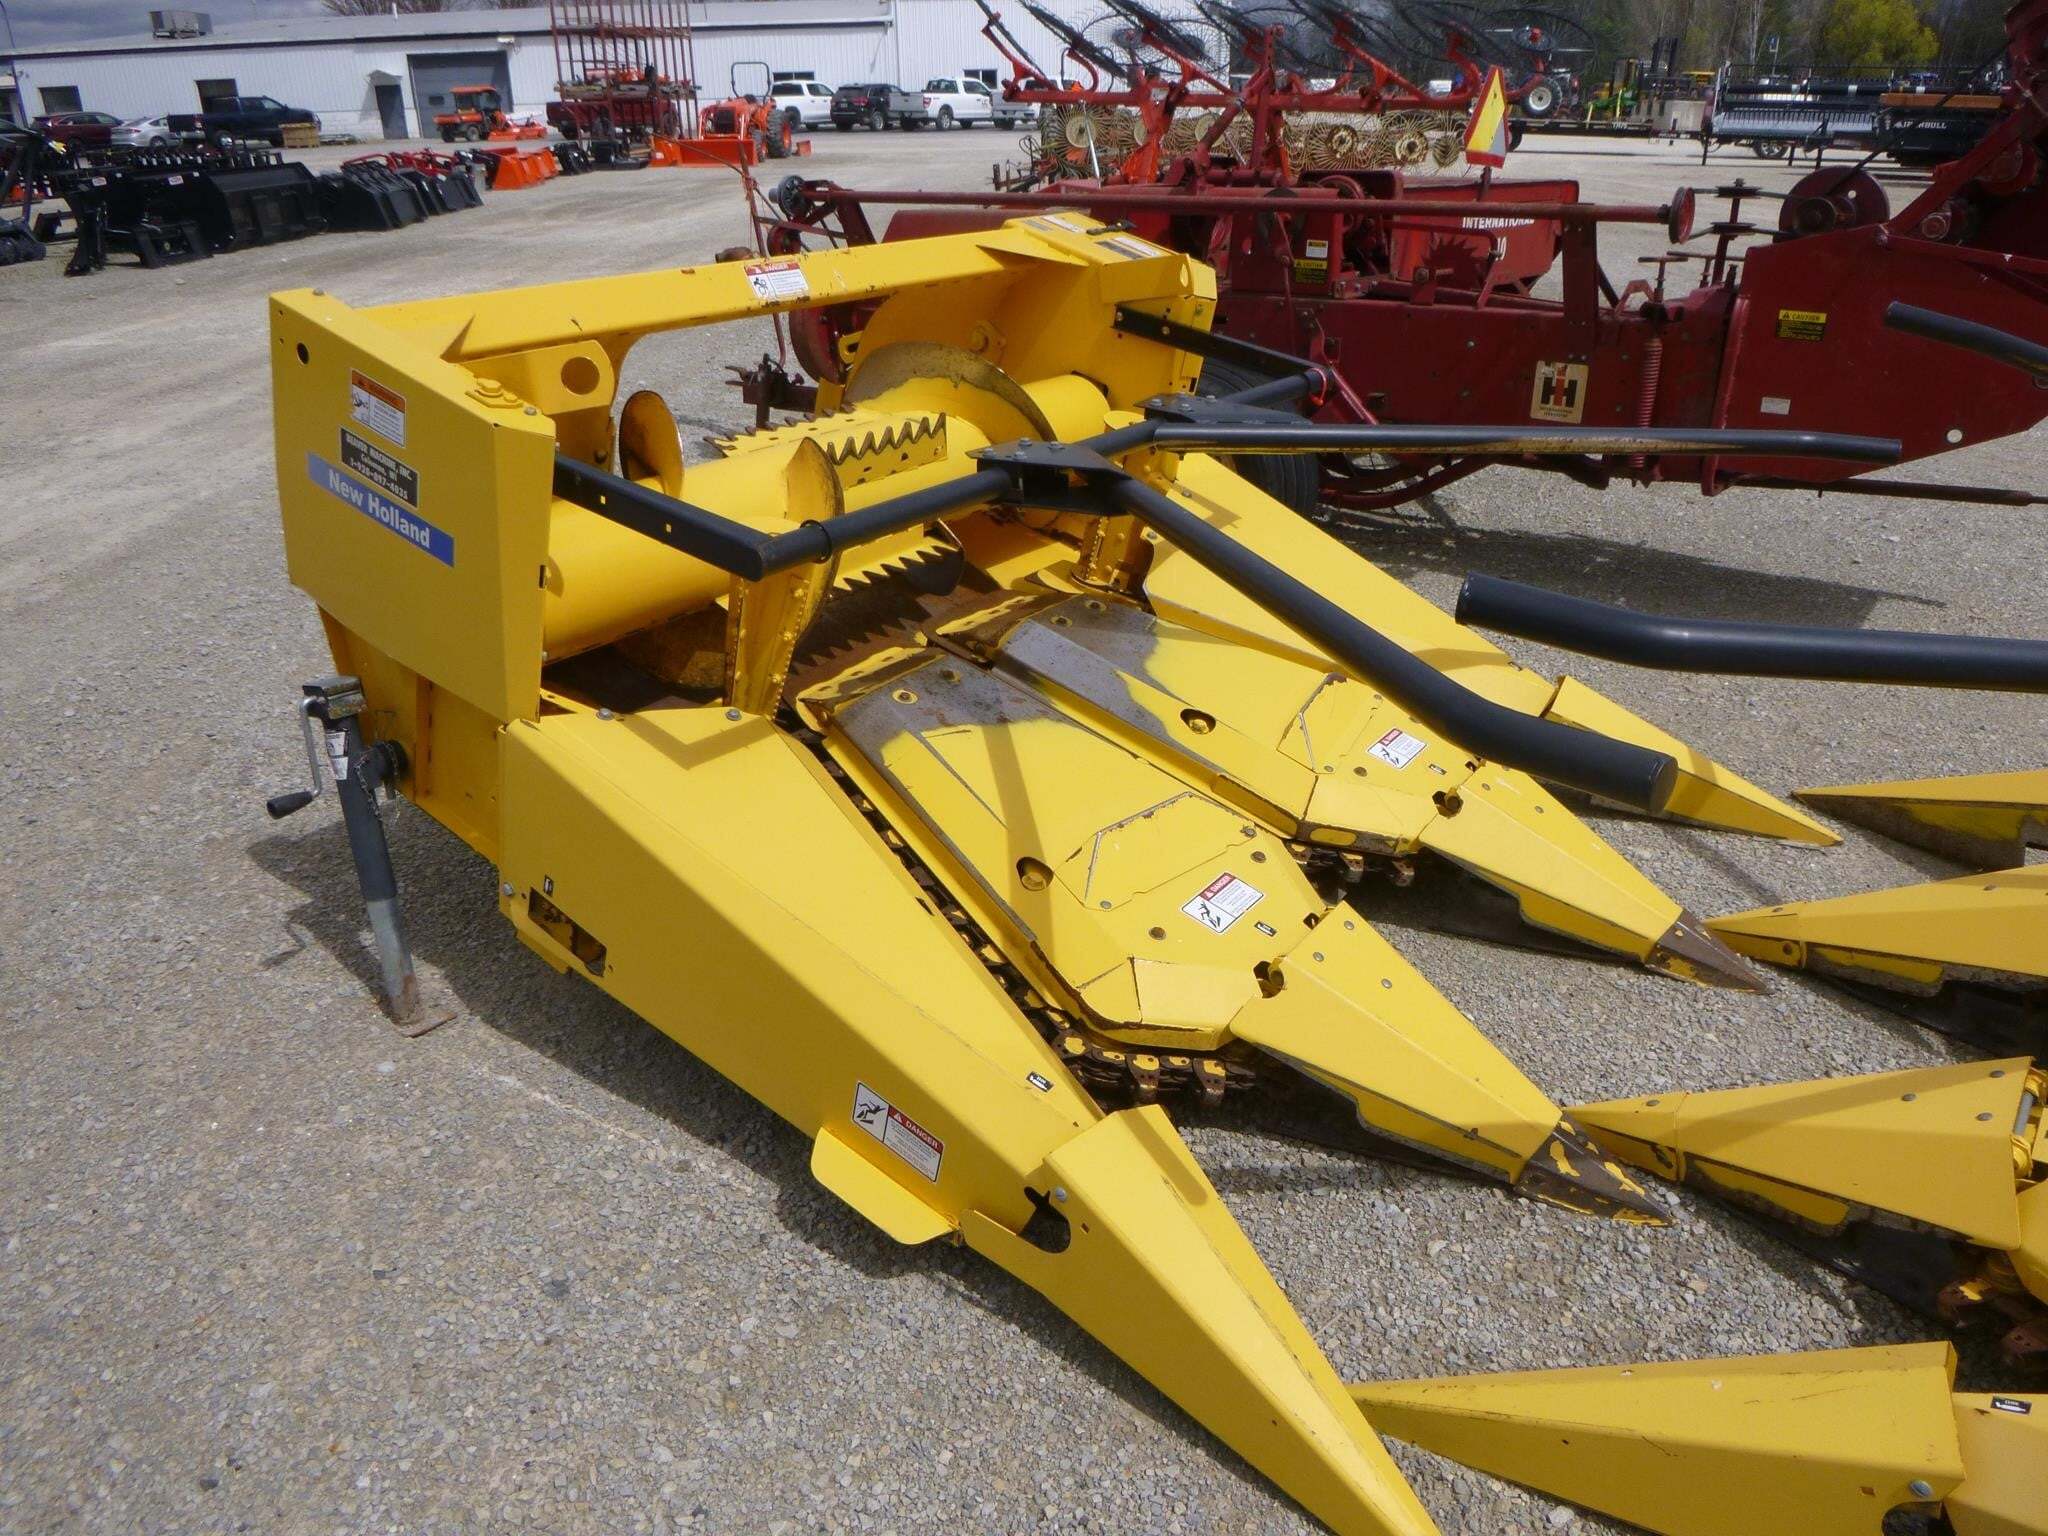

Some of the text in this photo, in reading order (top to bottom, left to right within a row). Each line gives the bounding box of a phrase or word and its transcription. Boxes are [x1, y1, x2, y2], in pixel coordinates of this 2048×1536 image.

[328, 469, 431, 549] New Holland
[905, 1120, 939, 1150] DANGER
